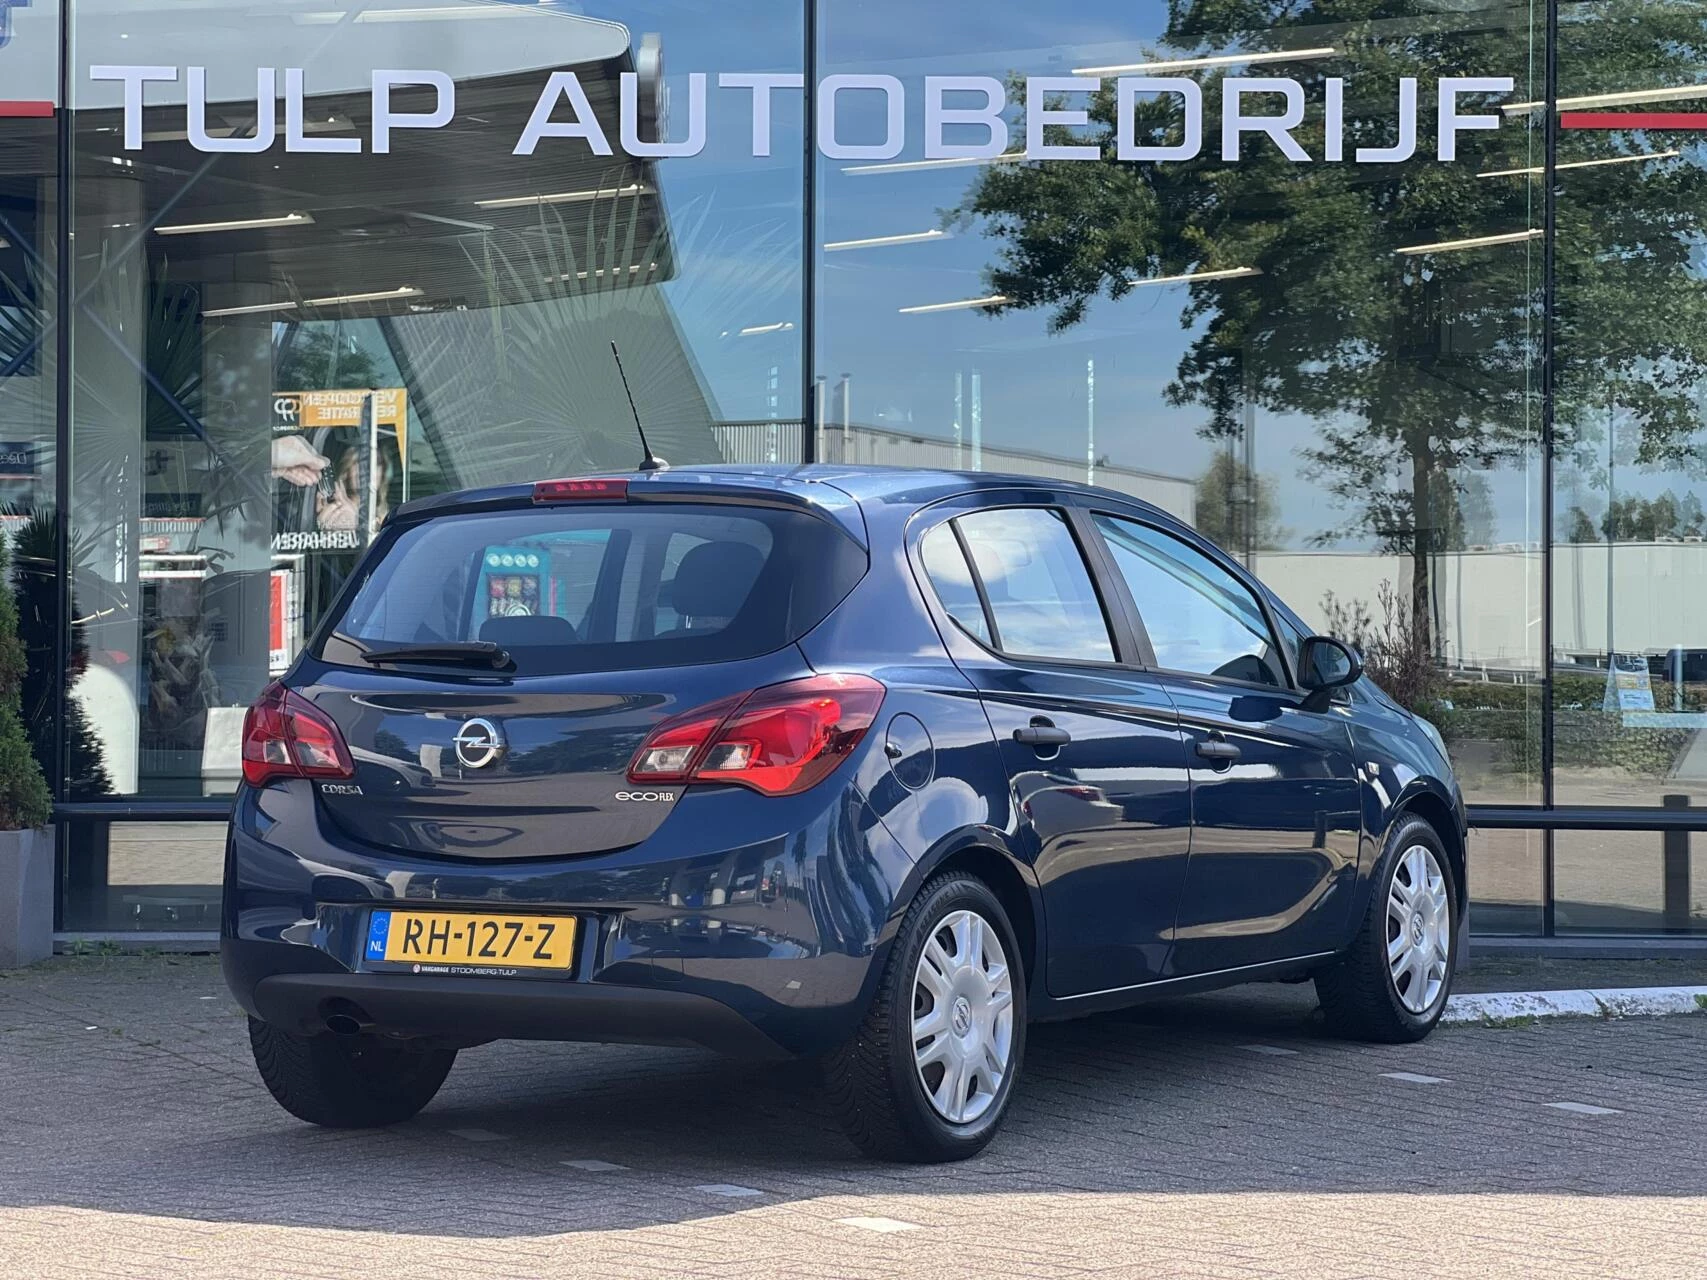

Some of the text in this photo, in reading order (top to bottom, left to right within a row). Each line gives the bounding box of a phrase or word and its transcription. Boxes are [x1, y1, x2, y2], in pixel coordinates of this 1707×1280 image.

[90, 65, 1514, 163] TULP AUTOBEDRIJF
[321, 784, 364, 795] CORSA
[370, 941, 384, 951] NL
[402, 919, 555, 960] RH-127-Z
